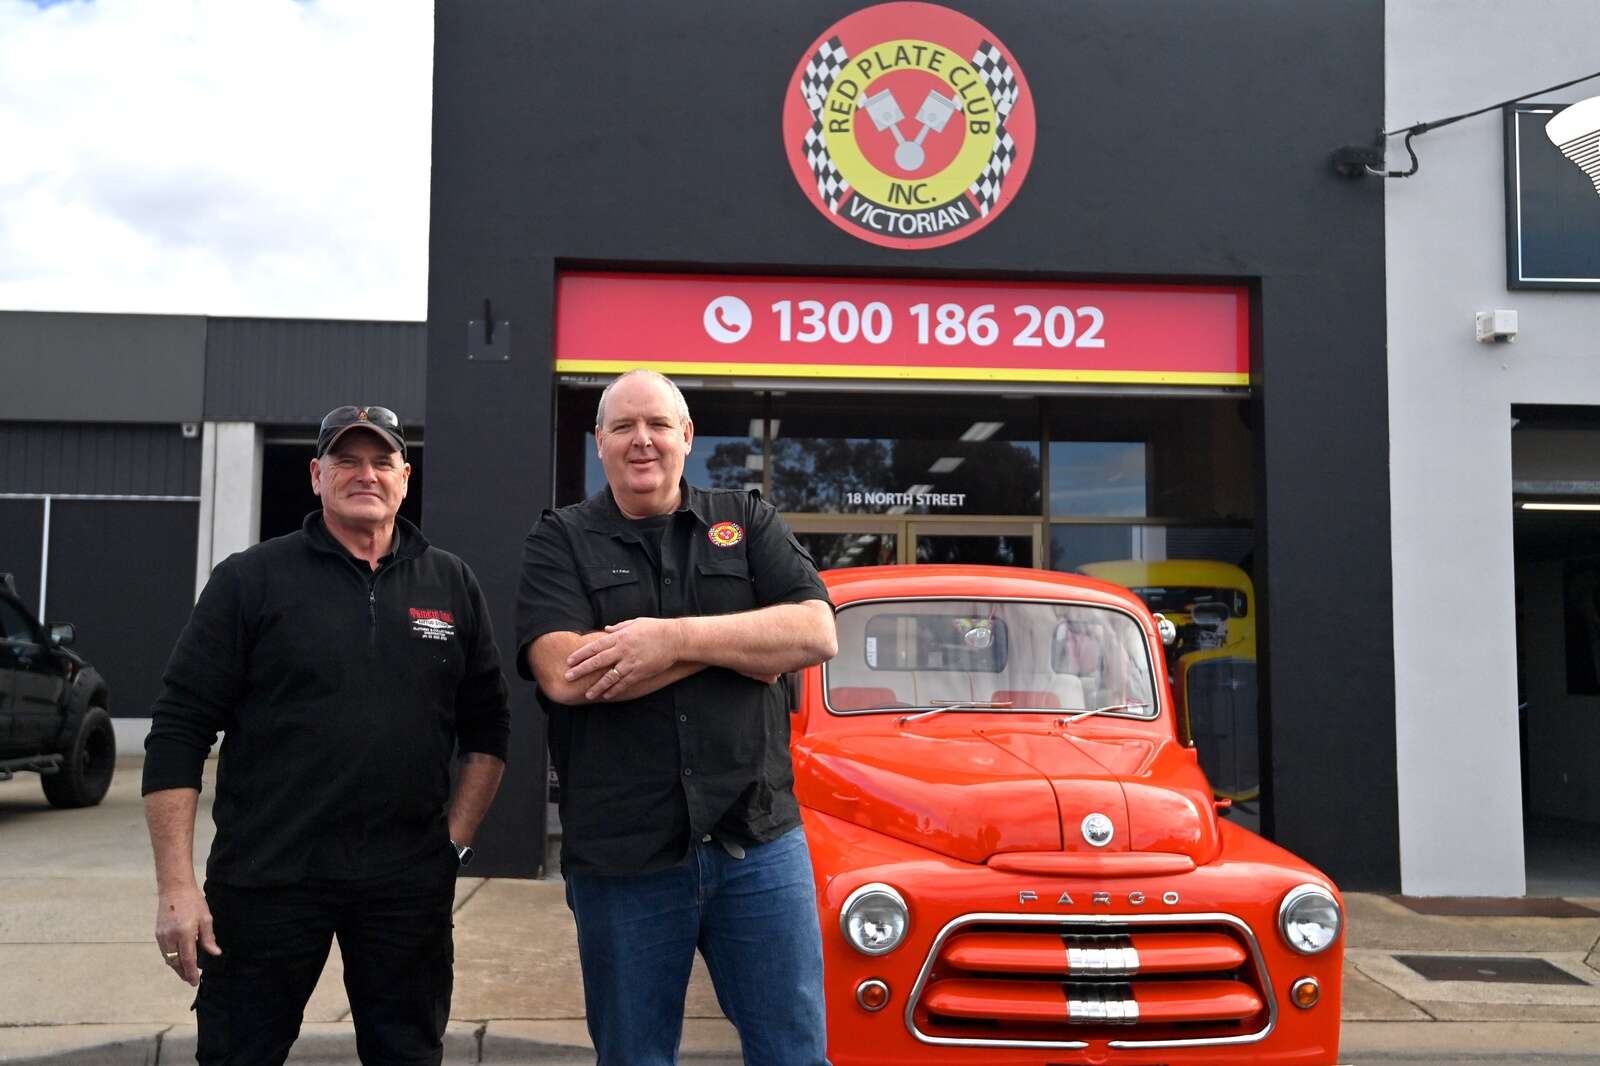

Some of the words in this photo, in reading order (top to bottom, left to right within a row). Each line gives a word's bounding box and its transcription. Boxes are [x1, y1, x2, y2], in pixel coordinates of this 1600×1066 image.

[829, 79, 859, 134] RED
[856, 45, 946, 80] PLATE
[949, 66, 990, 135] CLUB
[887, 182, 937, 205] INC.
[849, 196, 970, 234] VICTORIAN
[771, 300, 893, 344] 1300
[909, 303, 999, 346] 186
[1012, 304, 1105, 348] 202
[846, 492, 862, 504] 18
[864, 492, 914, 505] NORTH
[916, 493, 966, 506] STREET
[1019, 890, 1180, 905] FARGO
